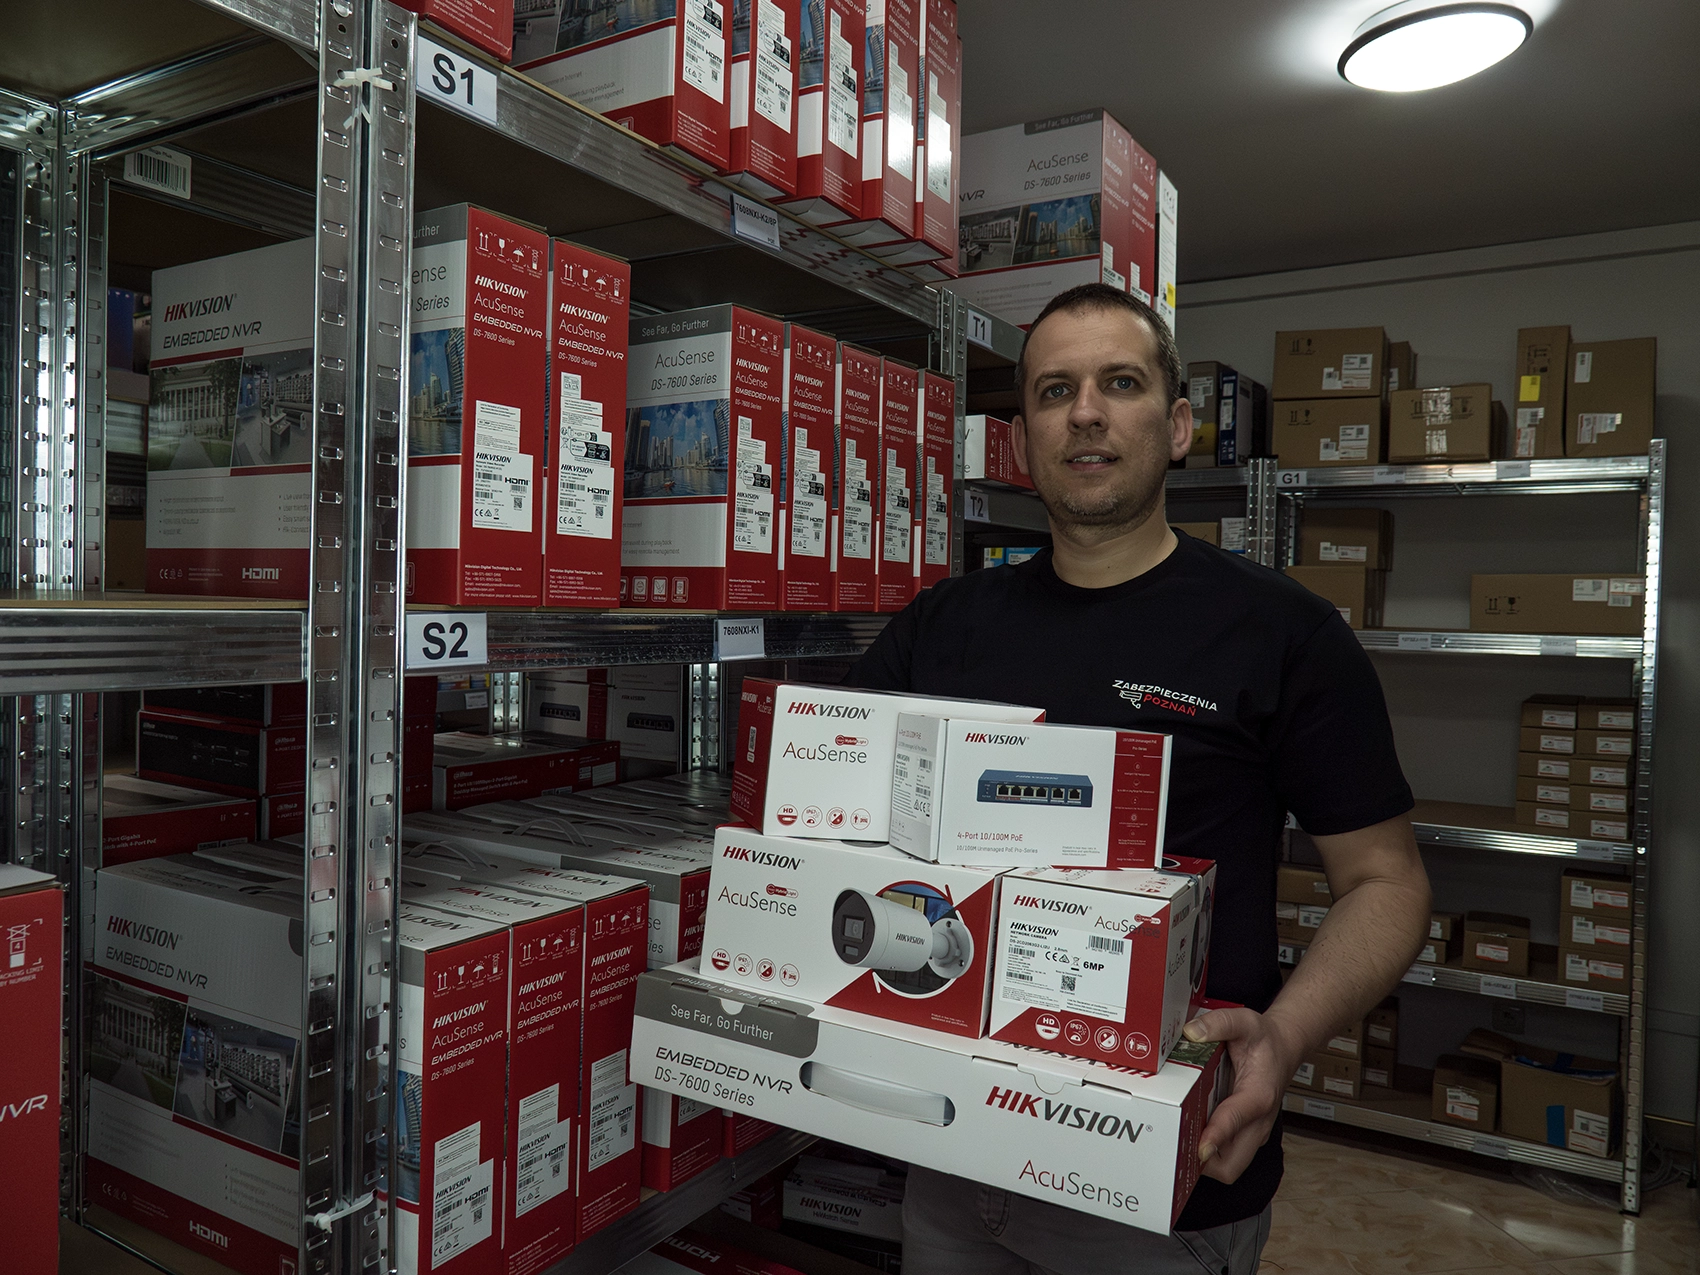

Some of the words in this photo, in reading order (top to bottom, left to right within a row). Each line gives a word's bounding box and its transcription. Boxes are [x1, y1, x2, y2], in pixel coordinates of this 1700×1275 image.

[432, 53, 474, 106] S1
[1026, 151, 1089, 173] AcuSense
[1024, 175, 1061, 191] DS-7600
[1063, 171, 1091, 184] Series
[413, 225, 440, 239] urther
[412, 265, 447, 285] ense
[474, 274, 527, 299] HIKVISION
[163, 293, 234, 323] HIKVISION
[416, 295, 450, 312] Series
[474, 292, 524, 319] AcuSense
[559, 302, 609, 324] HIKVISION
[163, 325, 230, 349] EMBEDDED
[232, 321, 262, 338] NVR
[473, 312, 523, 333] EMBEDDED
[524, 327, 543, 339] NVR
[559, 319, 607, 342] AcuSense
[641, 326, 655, 337] See
[656, 324, 670, 335] Far,
[671, 322, 681, 332] Go
[681, 319, 710, 331] Further
[972, 315, 986, 341] T1
[558, 337, 605, 356] EMBEDDED
[605, 349, 625, 361] NVR
[654, 349, 715, 369] AcuSense
[735, 357, 769, 374] HIKVISION
[651, 376, 687, 391] DS-7600
[689, 373, 717, 386] Series
[735, 372, 768, 389] AcuSense
[475, 452, 512, 464] HIKVISION
[561, 464, 594, 475] HIKVISION
[1281, 472, 1301, 485] G1
[504, 477, 529, 486] HDMI
[587, 487, 610, 495] HDMI
[970, 495, 983, 518] T2
[241, 567, 280, 580] HDMI
[421, 621, 469, 660] S2
[723, 625, 760, 636] 7608NXI-K1
[1112, 679, 1218, 712] ZABEZPIECZENIA
[1143, 693, 1197, 717] POZNAŃ
[787, 701, 871, 720] HIKVISION
[964, 732, 1027, 746] HIKVISION
[782, 741, 867, 764] AcuSense
[957, 831, 978, 840] 4-Port
[980, 832, 1009, 841] 10/100M
[1010, 833, 1023, 842] PoE
[723, 845, 801, 871] HIKVISION
[717, 885, 797, 917] AcuSense
[1013, 894, 1090, 916] HIKVISION
[107, 915, 180, 950] HIKVISION
[1010, 921, 1060, 937] HIKVISION
[1094, 915, 1161, 938] AcuSense
[895, 933, 926, 946] HIKVISION
[591, 946, 632, 967] HIKVISION
[715, 951, 727, 959] HD
[1083, 961, 1105, 971] 6MP
[106, 946, 174, 979] EMBEDDED
[176, 970, 208, 989] NVR
[590, 962, 630, 985] AcuSense
[518, 972, 565, 996] HIKVISION
[589, 978, 628, 998] EMBEDDED
[517, 989, 563, 1015] AcuSense
[432, 1001, 487, 1029] HIKVISION
[517, 1005, 561, 1029] EMBEDDED
[561, 999, 579, 1013] NVR
[670, 1003, 691, 1020] See
[692, 1009, 713, 1027] Far,
[716, 1015, 731, 1030] Go
[733, 1020, 774, 1041] Further
[1042, 1017, 1055, 1025] HD
[431, 1020, 484, 1050] AcuSense
[431, 1038, 483, 1066] EMBEDDED
[482, 1030, 503, 1046] NVR
[457, 1057, 475, 1072] Series
[655, 1046, 751, 1082] EMBEDDED
[752, 1073, 793, 1095] NVR
[654, 1066, 711, 1094] DS-7600
[712, 1083, 755, 1107] Series
[591, 1094, 620, 1112] HIKVISION
[985, 1085, 1144, 1143] HIKVISION
[519, 1132, 551, 1153] HIKVISION
[435, 1175, 472, 1199] HIKVISION
[464, 1186, 490, 1204] HDMI
[1018, 1159, 1140, 1213] AcuSense
[799, 1196, 863, 1218] HIKVISION
[189, 1220, 230, 1248] HDMI
